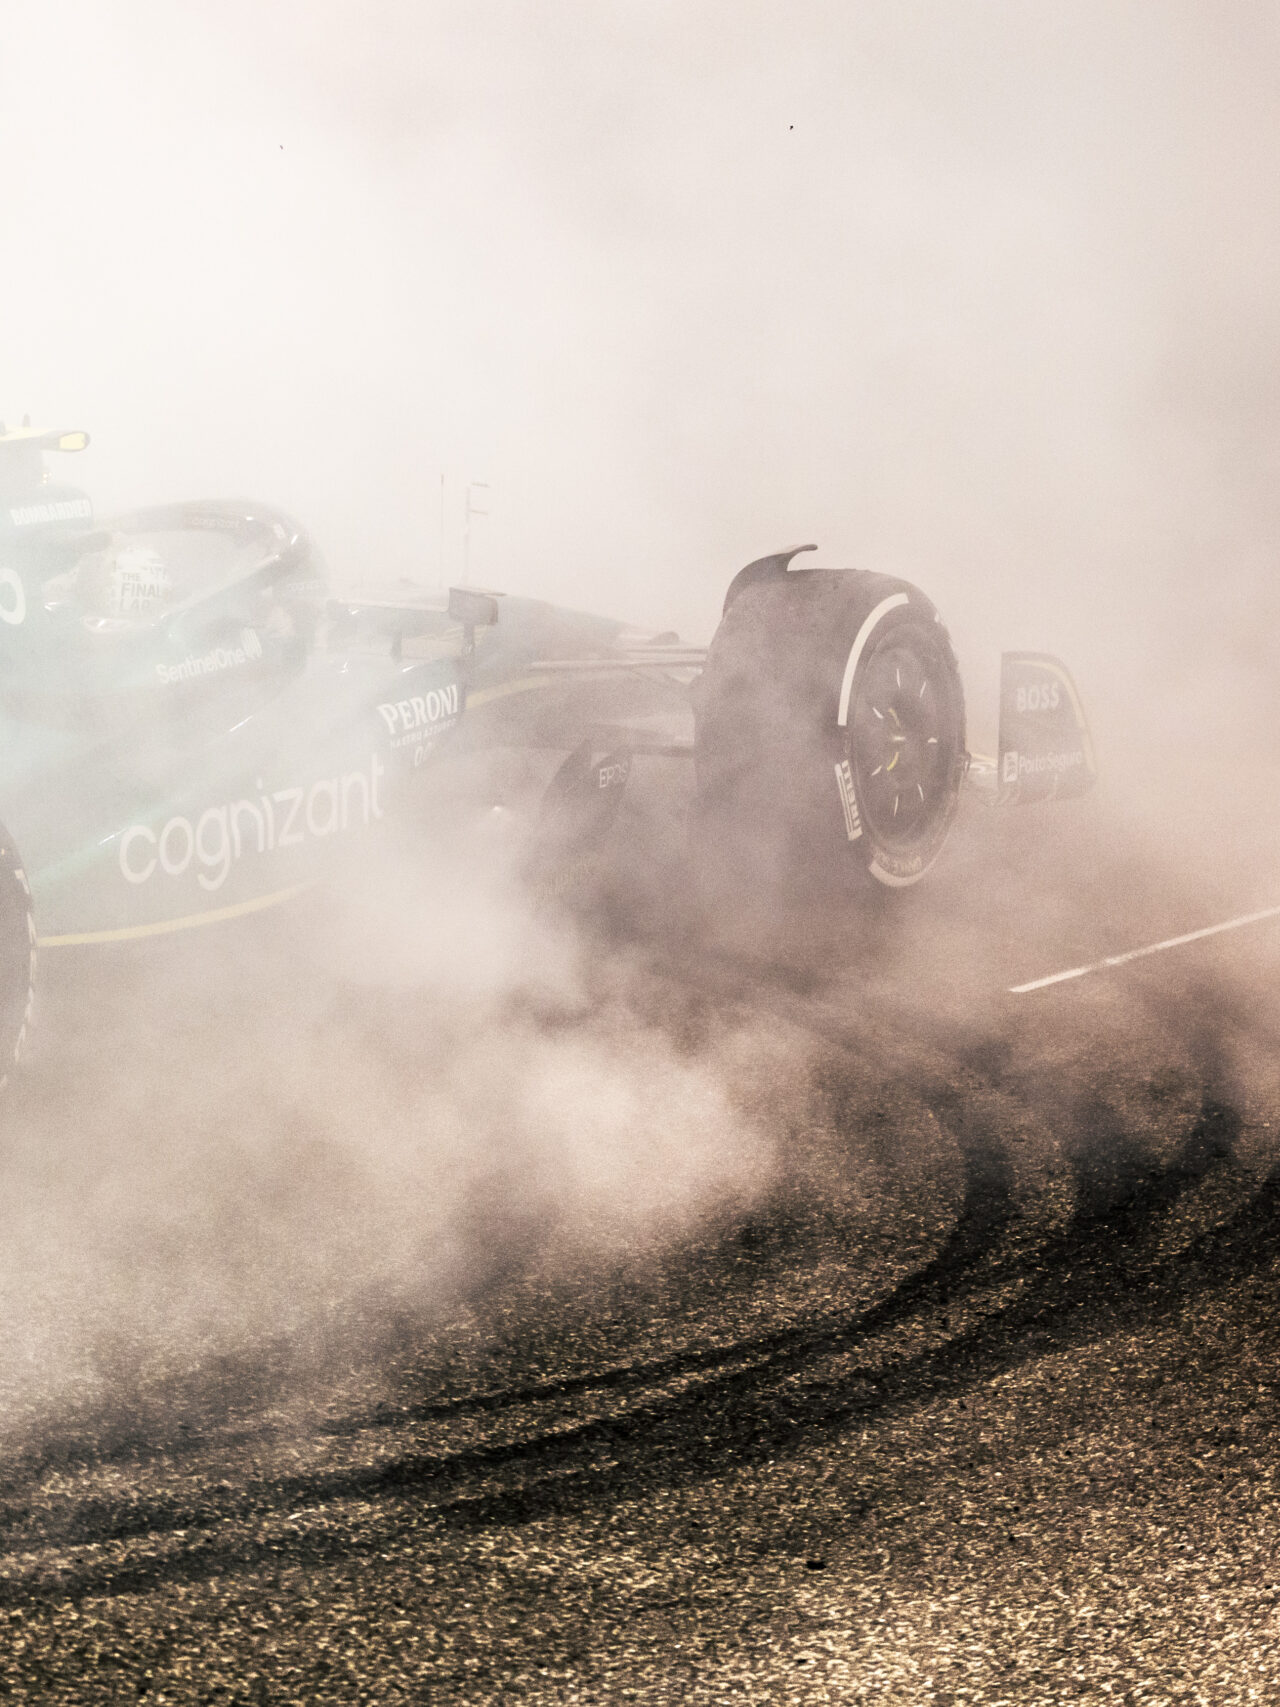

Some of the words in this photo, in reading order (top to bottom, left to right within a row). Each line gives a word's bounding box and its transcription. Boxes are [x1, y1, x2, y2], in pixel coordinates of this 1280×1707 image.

[121, 572, 141, 582] THE
[121, 583, 162, 598] FINAL
[155, 647, 246, 684] SentinelOne
[375, 683, 458, 735] PERONI
[1015, 681, 1060, 712] BOSS
[834, 759, 863, 841] PIRELLI
[119, 751, 385, 891] cognizant
